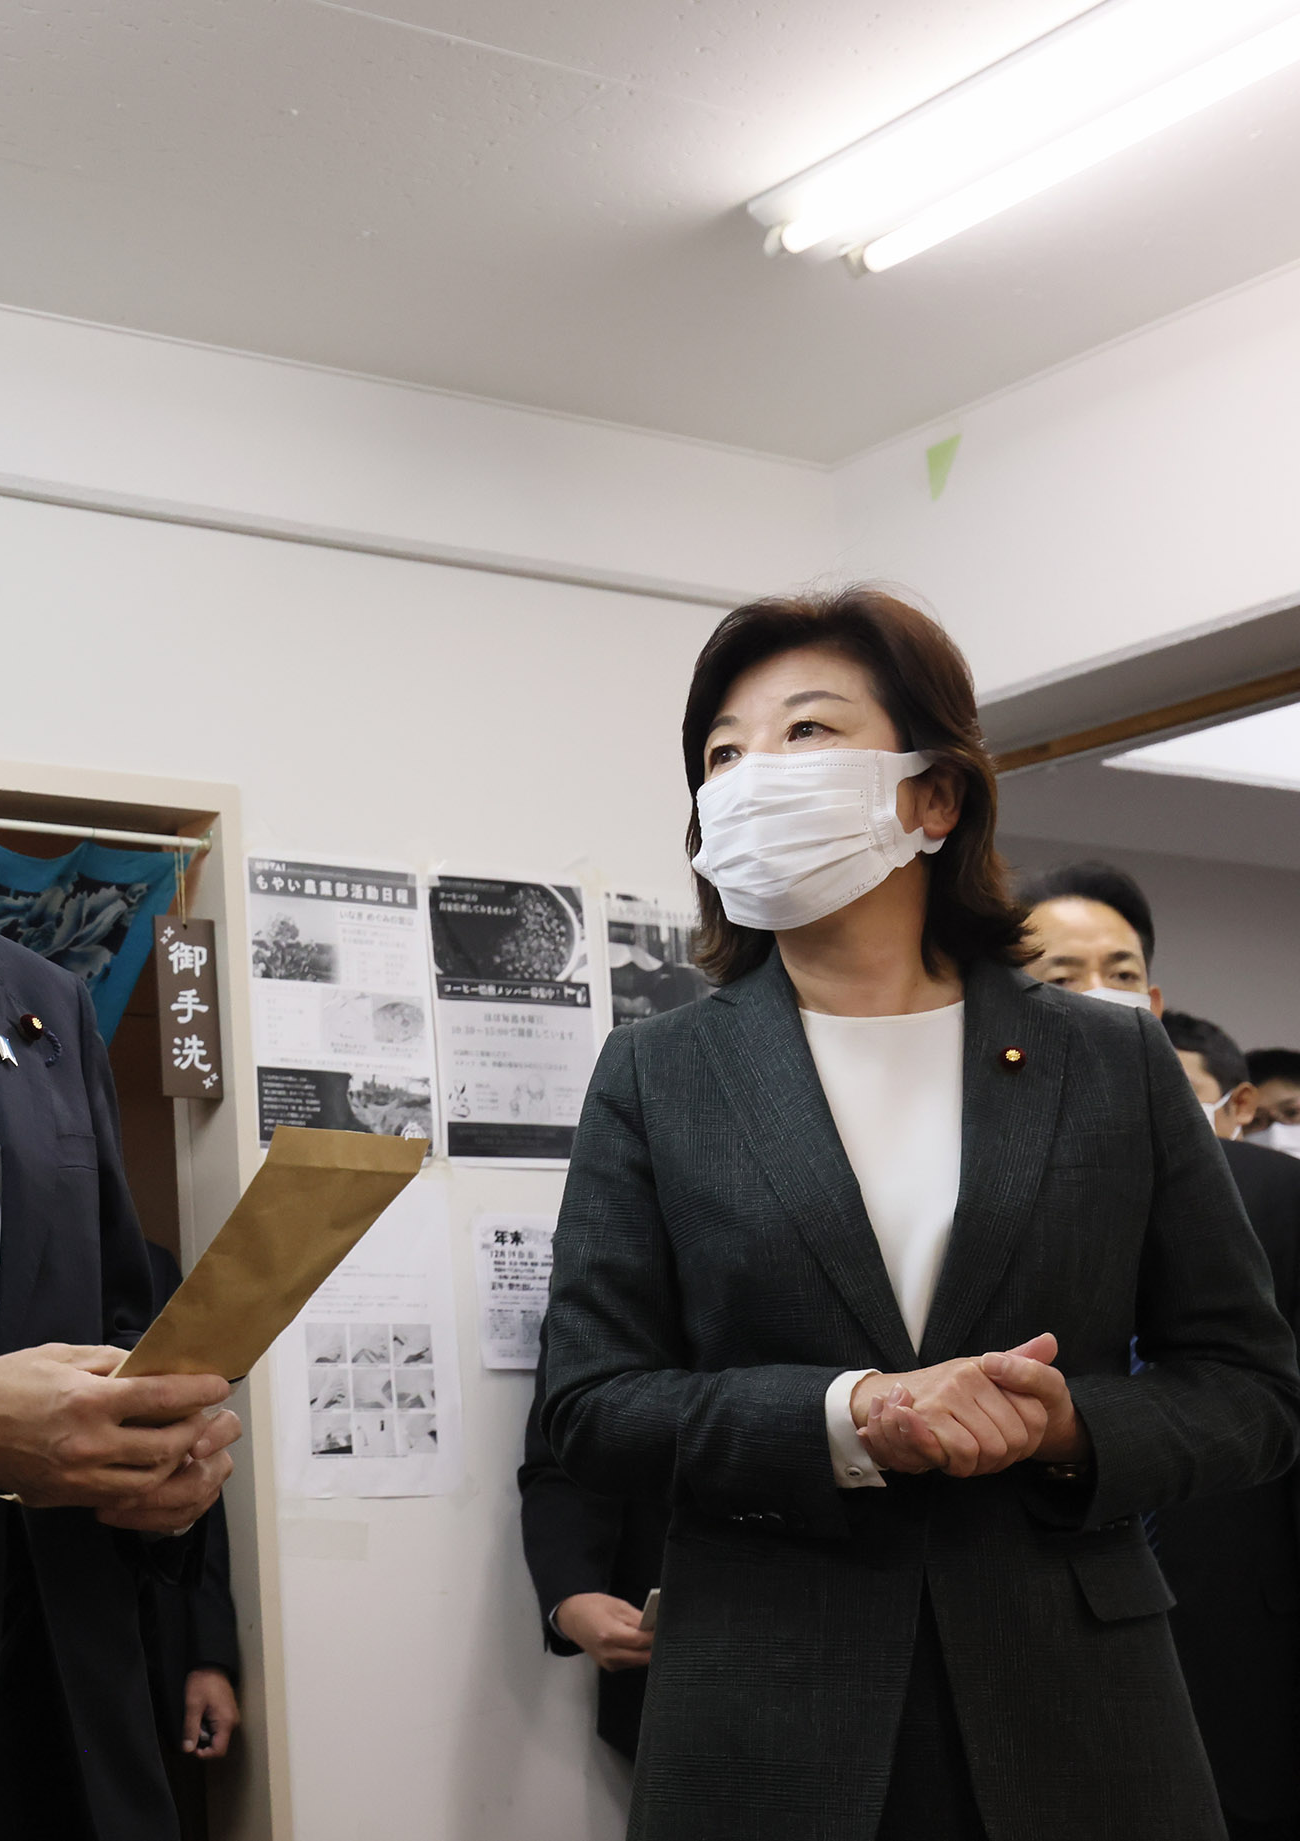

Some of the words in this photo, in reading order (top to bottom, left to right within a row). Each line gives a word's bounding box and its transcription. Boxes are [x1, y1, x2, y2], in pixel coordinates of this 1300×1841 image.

[256, 875, 409, 904] もやい農業部活動日程
[168, 941, 212, 1072] 御手洗
